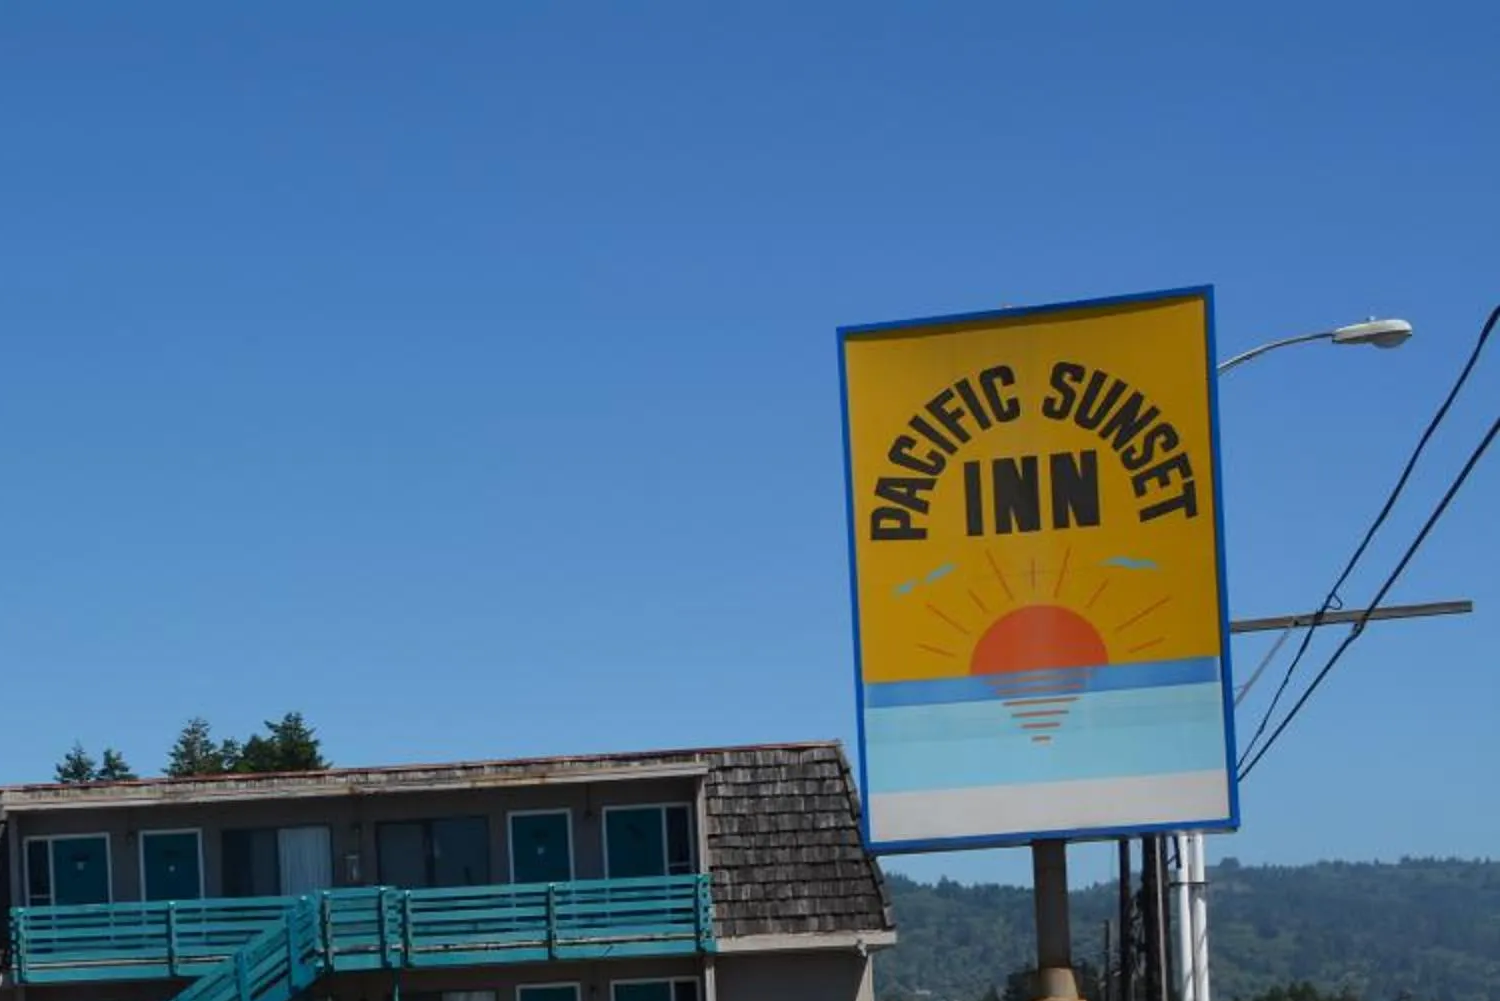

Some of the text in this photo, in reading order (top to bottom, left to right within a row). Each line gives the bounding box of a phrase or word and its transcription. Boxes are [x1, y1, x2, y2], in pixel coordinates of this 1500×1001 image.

[870, 361, 1198, 540] PACIFIC SUNSET
[964, 449, 1100, 536] INN
